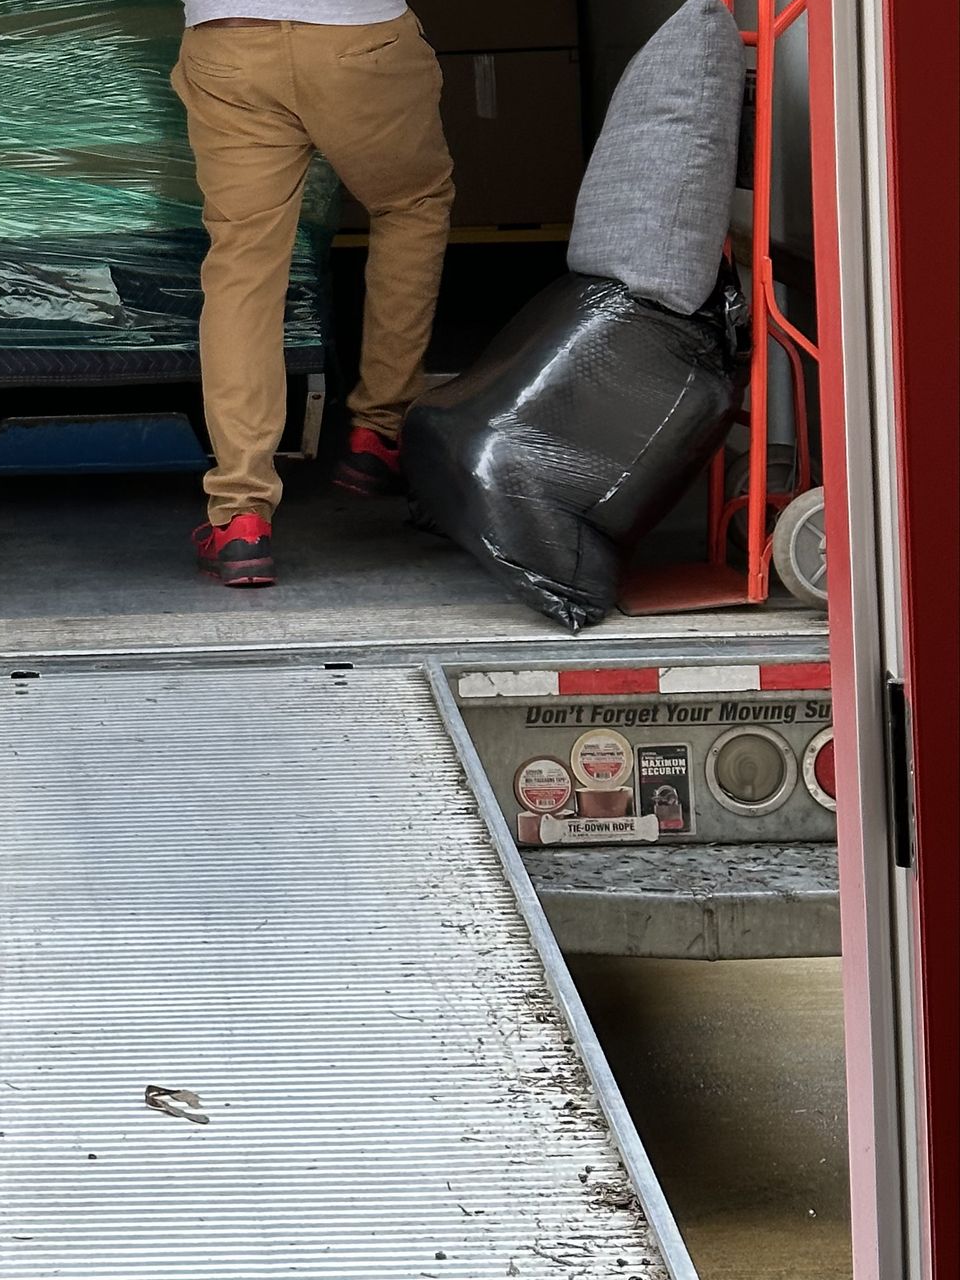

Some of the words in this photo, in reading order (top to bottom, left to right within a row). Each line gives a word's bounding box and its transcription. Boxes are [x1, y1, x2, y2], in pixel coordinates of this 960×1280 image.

[525, 704, 584, 724] Don't
[590, 705, 659, 726] Forget
[666, 704, 713, 723] Your
[719, 703, 797, 724] Moving
[804, 702, 831, 720] Su
[641, 759, 686, 768] MAXIMUM
[641, 767, 687, 776] SECURITY
[568, 823, 610, 832] TIE-DOWN
[613, 822, 635, 831] ROPE
